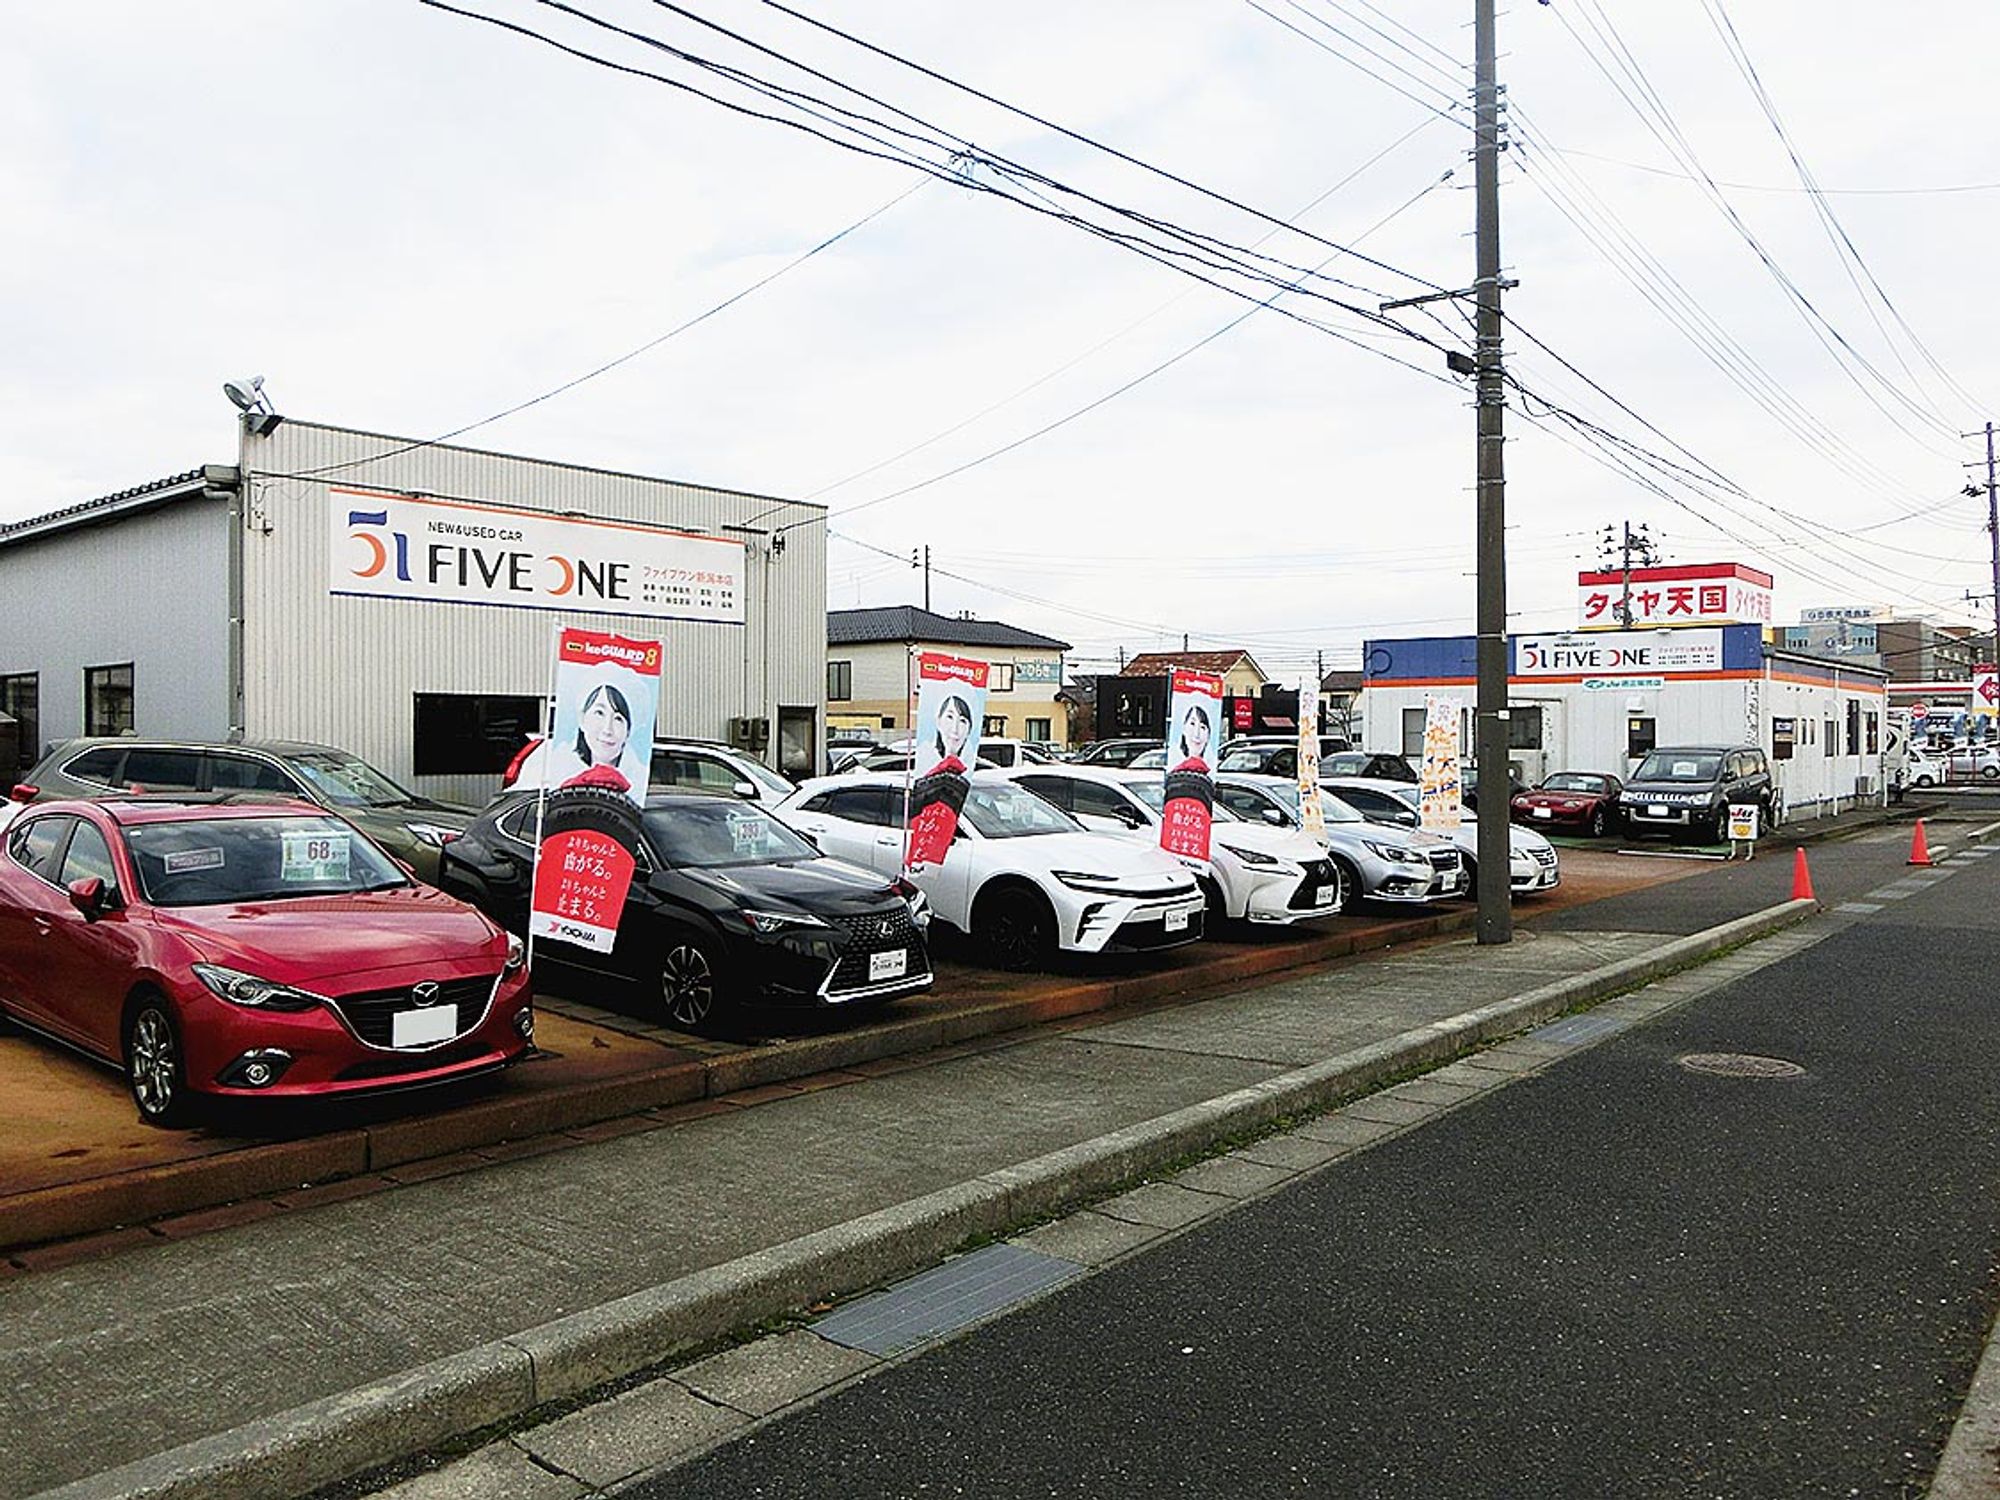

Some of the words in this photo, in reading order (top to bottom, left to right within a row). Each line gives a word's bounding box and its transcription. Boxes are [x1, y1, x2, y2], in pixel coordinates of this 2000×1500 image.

[428, 521, 496, 540] NEW&USED
[499, 529, 524, 542] CAR
[429, 544, 534, 592] FIVE
[545, 555, 631, 601] ONE
[1554, 649, 1601, 668] FIVE
[1607, 647, 1651, 667] ONE
[308, 841, 330, 860] 68
